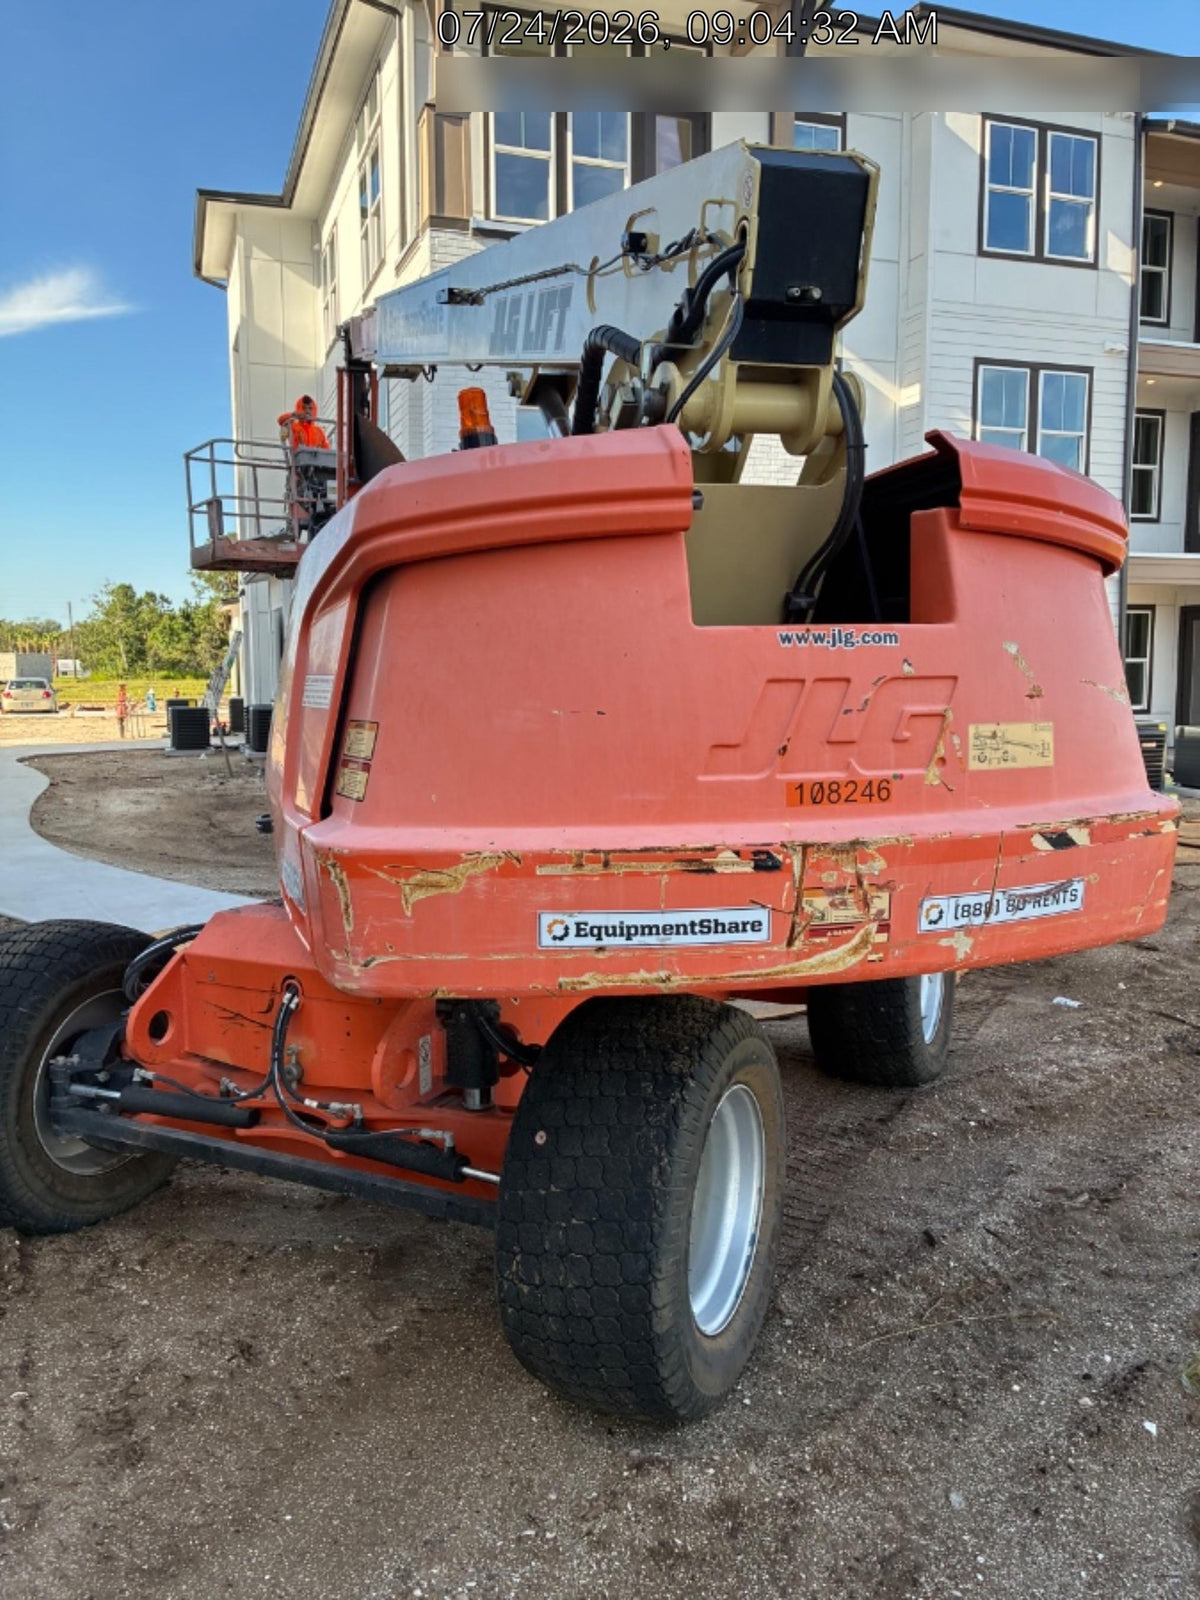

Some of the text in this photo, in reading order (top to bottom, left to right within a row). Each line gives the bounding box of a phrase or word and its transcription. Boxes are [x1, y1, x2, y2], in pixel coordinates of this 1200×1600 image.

[778, 629, 900, 649] www.jlg.com
[697, 675, 959, 781] JLG
[793, 778, 892, 805] 108246
[573, 917, 763, 941] EquipmentShare
